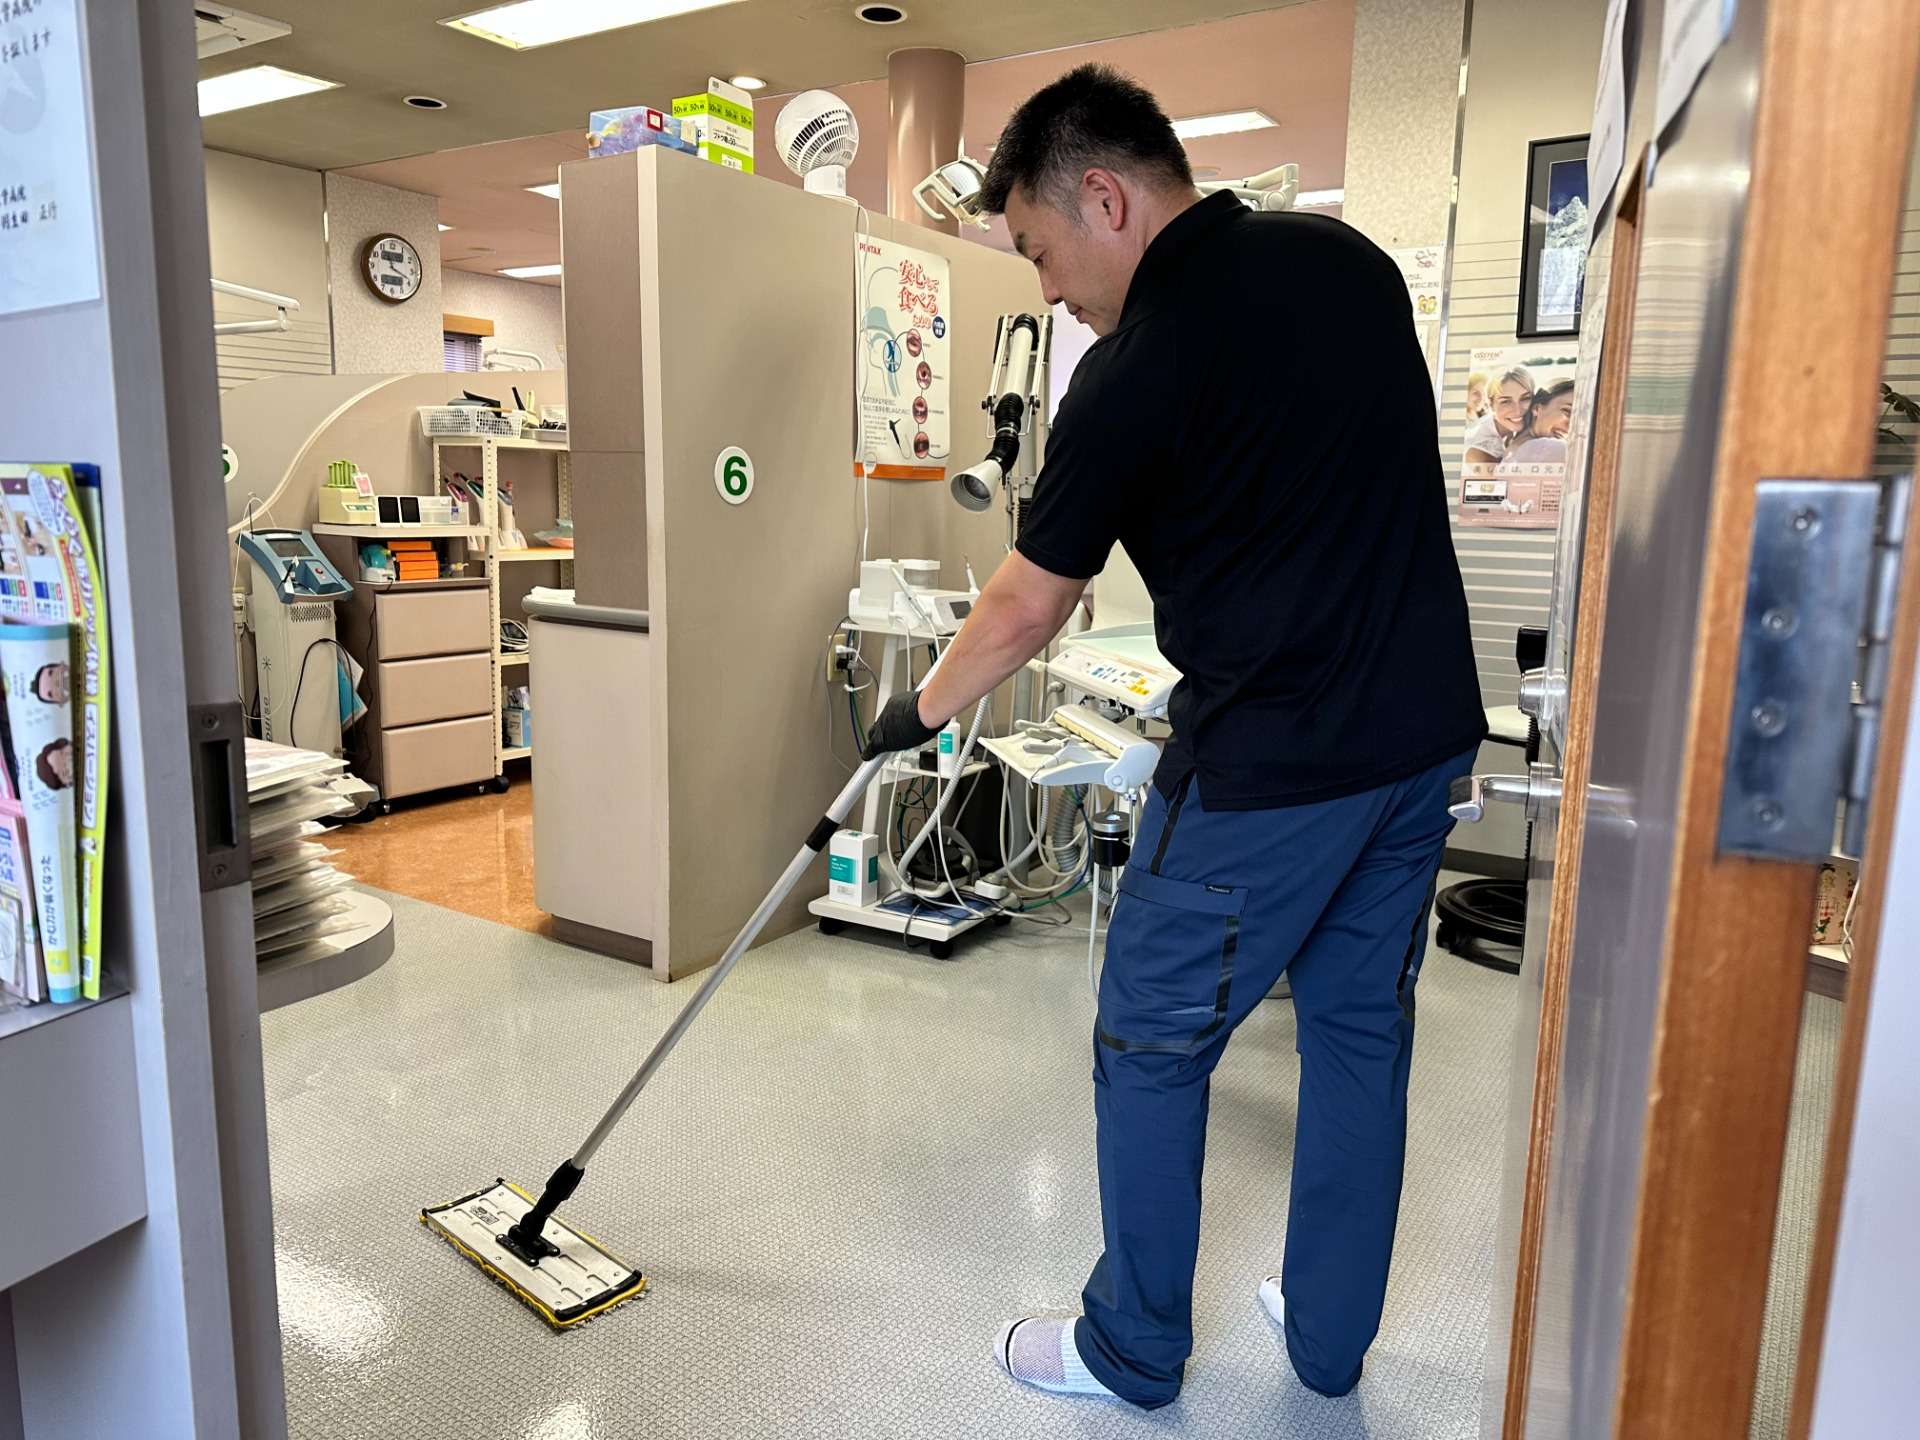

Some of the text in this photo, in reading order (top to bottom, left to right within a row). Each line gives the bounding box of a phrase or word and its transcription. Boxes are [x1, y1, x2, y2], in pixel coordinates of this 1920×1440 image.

[859, 242, 881, 256] PENTAX
[899, 286, 938, 316] 食べる
[723, 455, 748, 497] 6
[84, 711, 96, 821] イスバージョン
